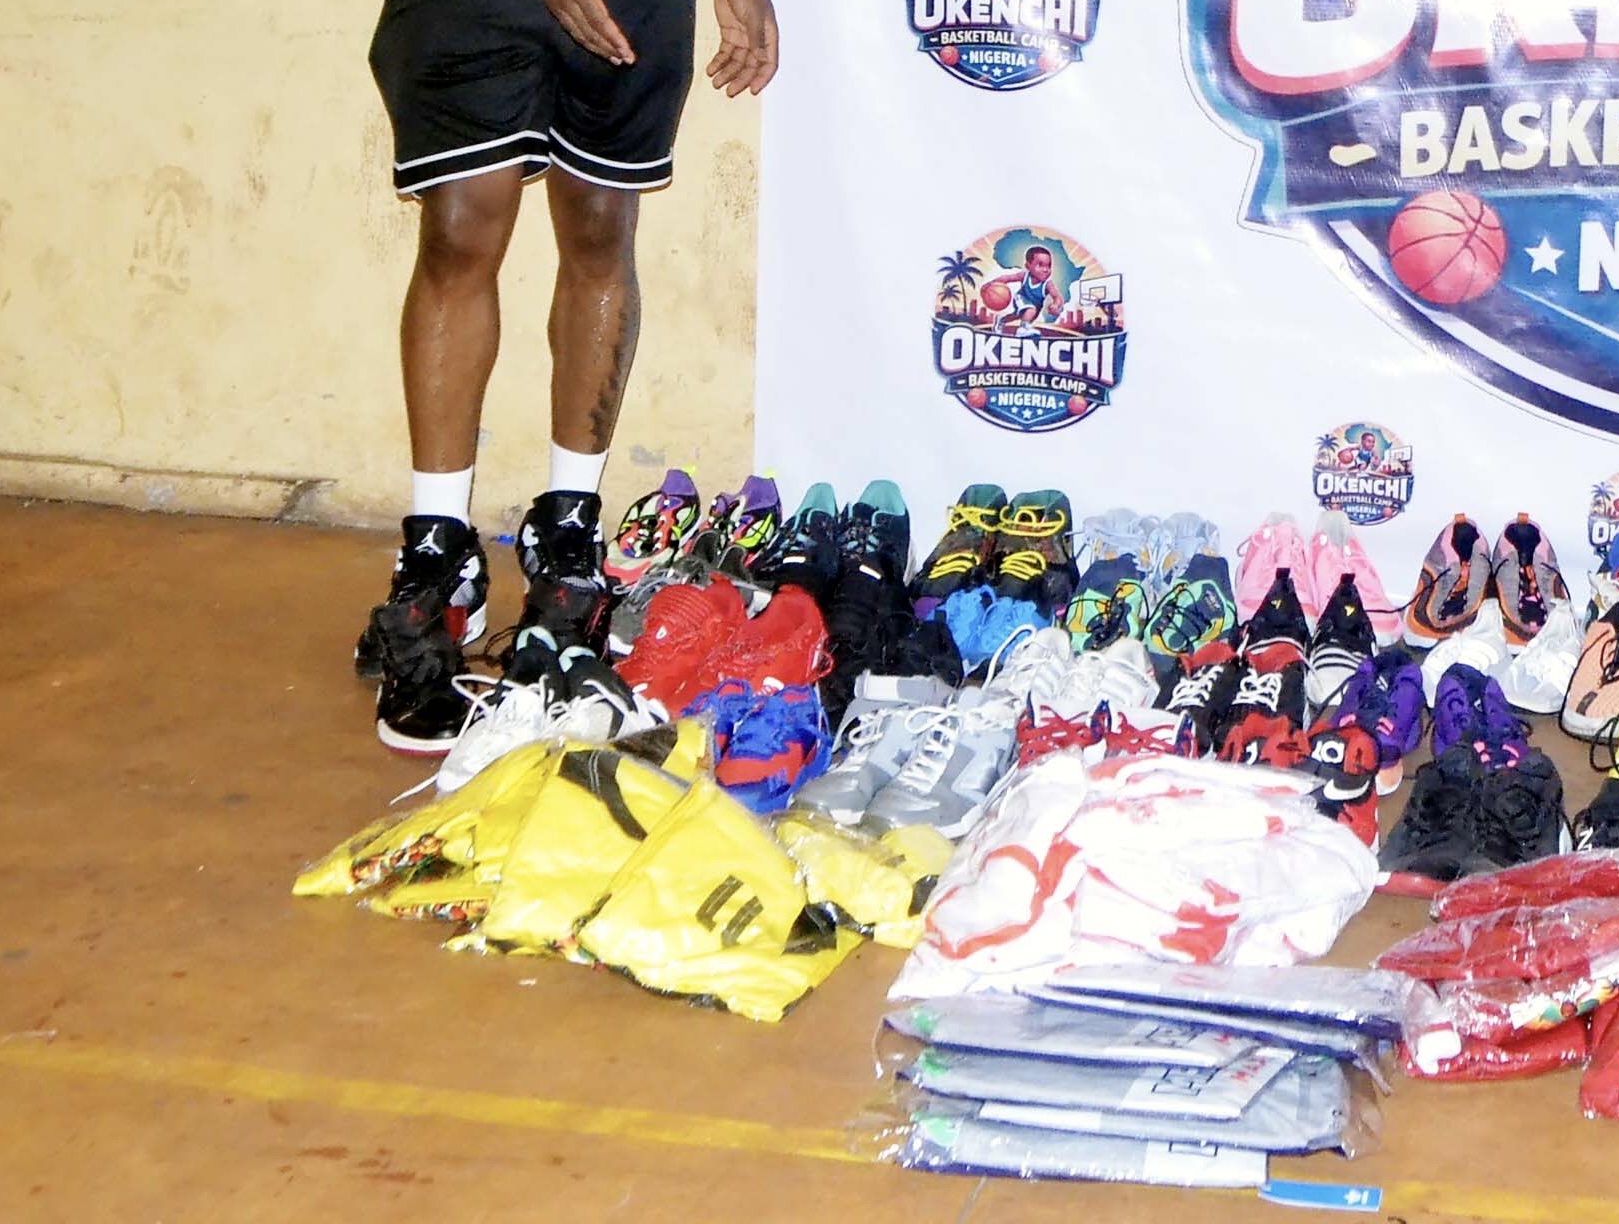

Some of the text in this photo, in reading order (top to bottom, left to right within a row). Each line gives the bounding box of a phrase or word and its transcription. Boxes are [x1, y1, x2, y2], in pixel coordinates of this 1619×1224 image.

[940, 30, 1059, 50] BASKETBALL CAMP
[969, 50, 1026, 67] NIGERIA
[940, 328, 1114, 386] OKENCHI
[968, 374, 1086, 394] BASKETBALL CAMP
[998, 393, 1056, 409] NIGERIA
[1317, 473, 1408, 501] OKENCHI
[1346, 506, 1376, 514] NIGERIA
